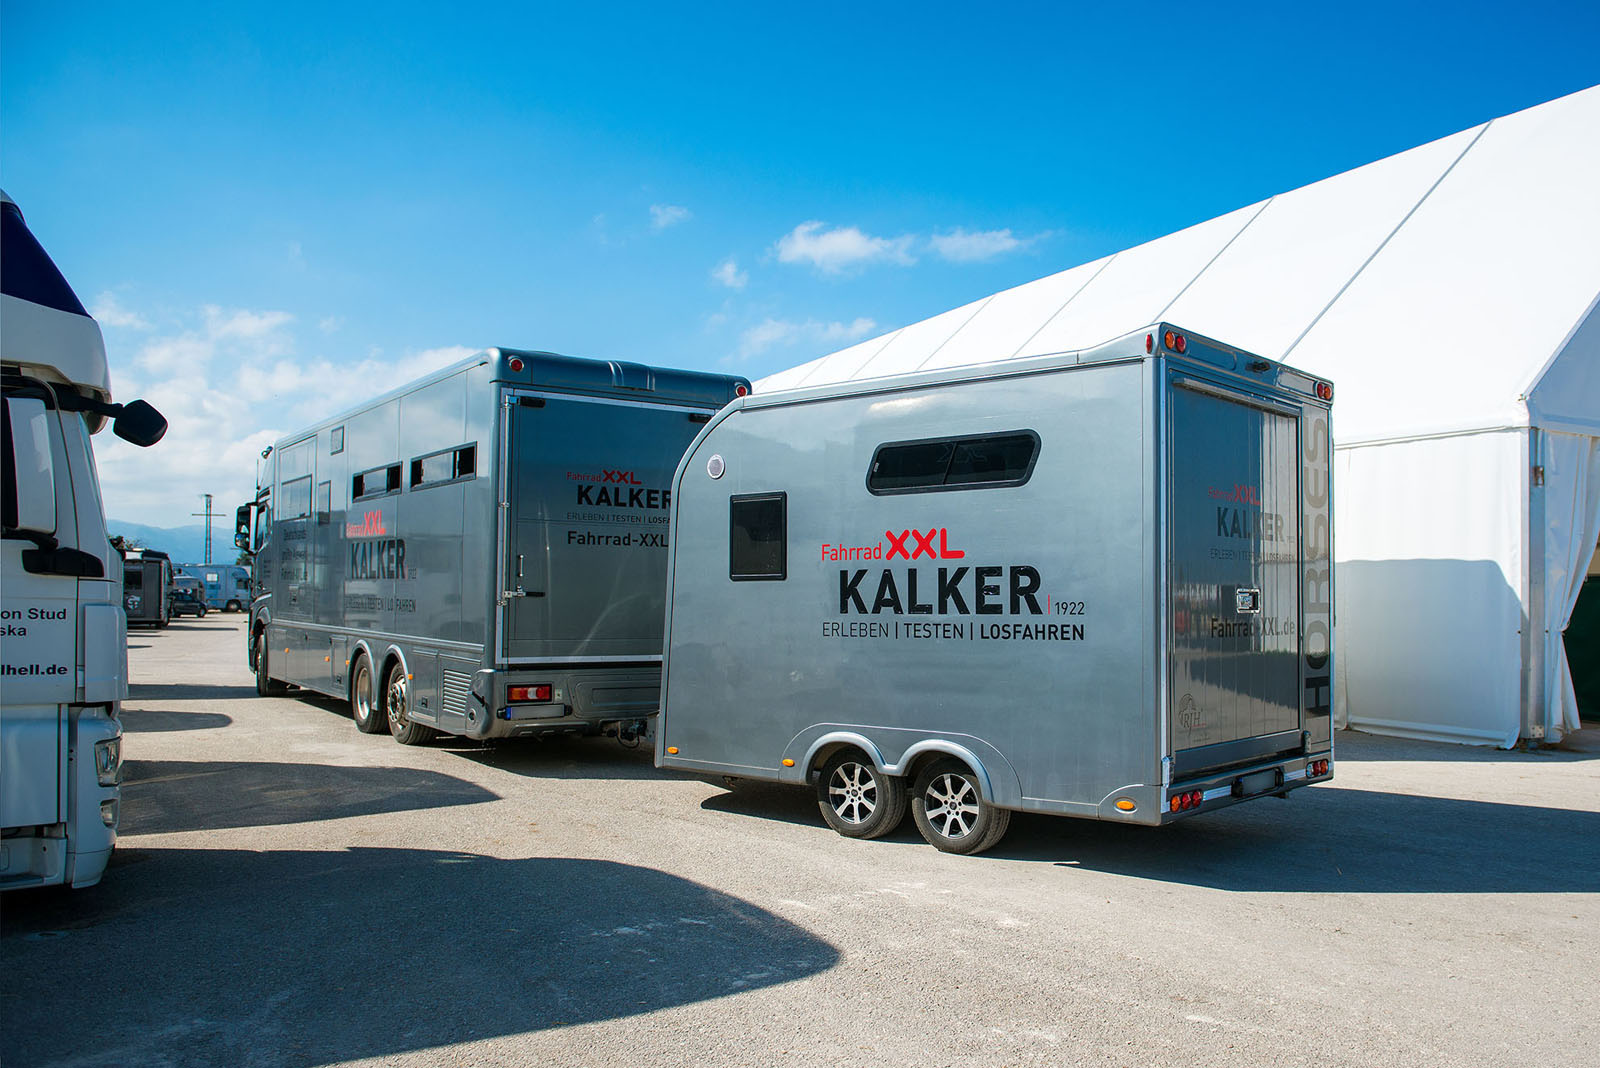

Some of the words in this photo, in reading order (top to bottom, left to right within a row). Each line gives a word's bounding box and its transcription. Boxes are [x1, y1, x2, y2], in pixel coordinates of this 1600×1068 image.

[566, 512, 605, 521] ERLEBEN
[612, 514, 642, 523] TESTEN
[351, 538, 406, 579] KALKER
[1304, 415, 1329, 716] HORSES
[839, 565, 1043, 615] KALKER
[1054, 601, 1085, 616] 1922
[27, 607, 67, 620] Stud
[822, 622, 889, 638] ERLEBEN
[904, 623, 964, 639] TESTEN
[980, 623, 1084, 641] LOSFAHREN
